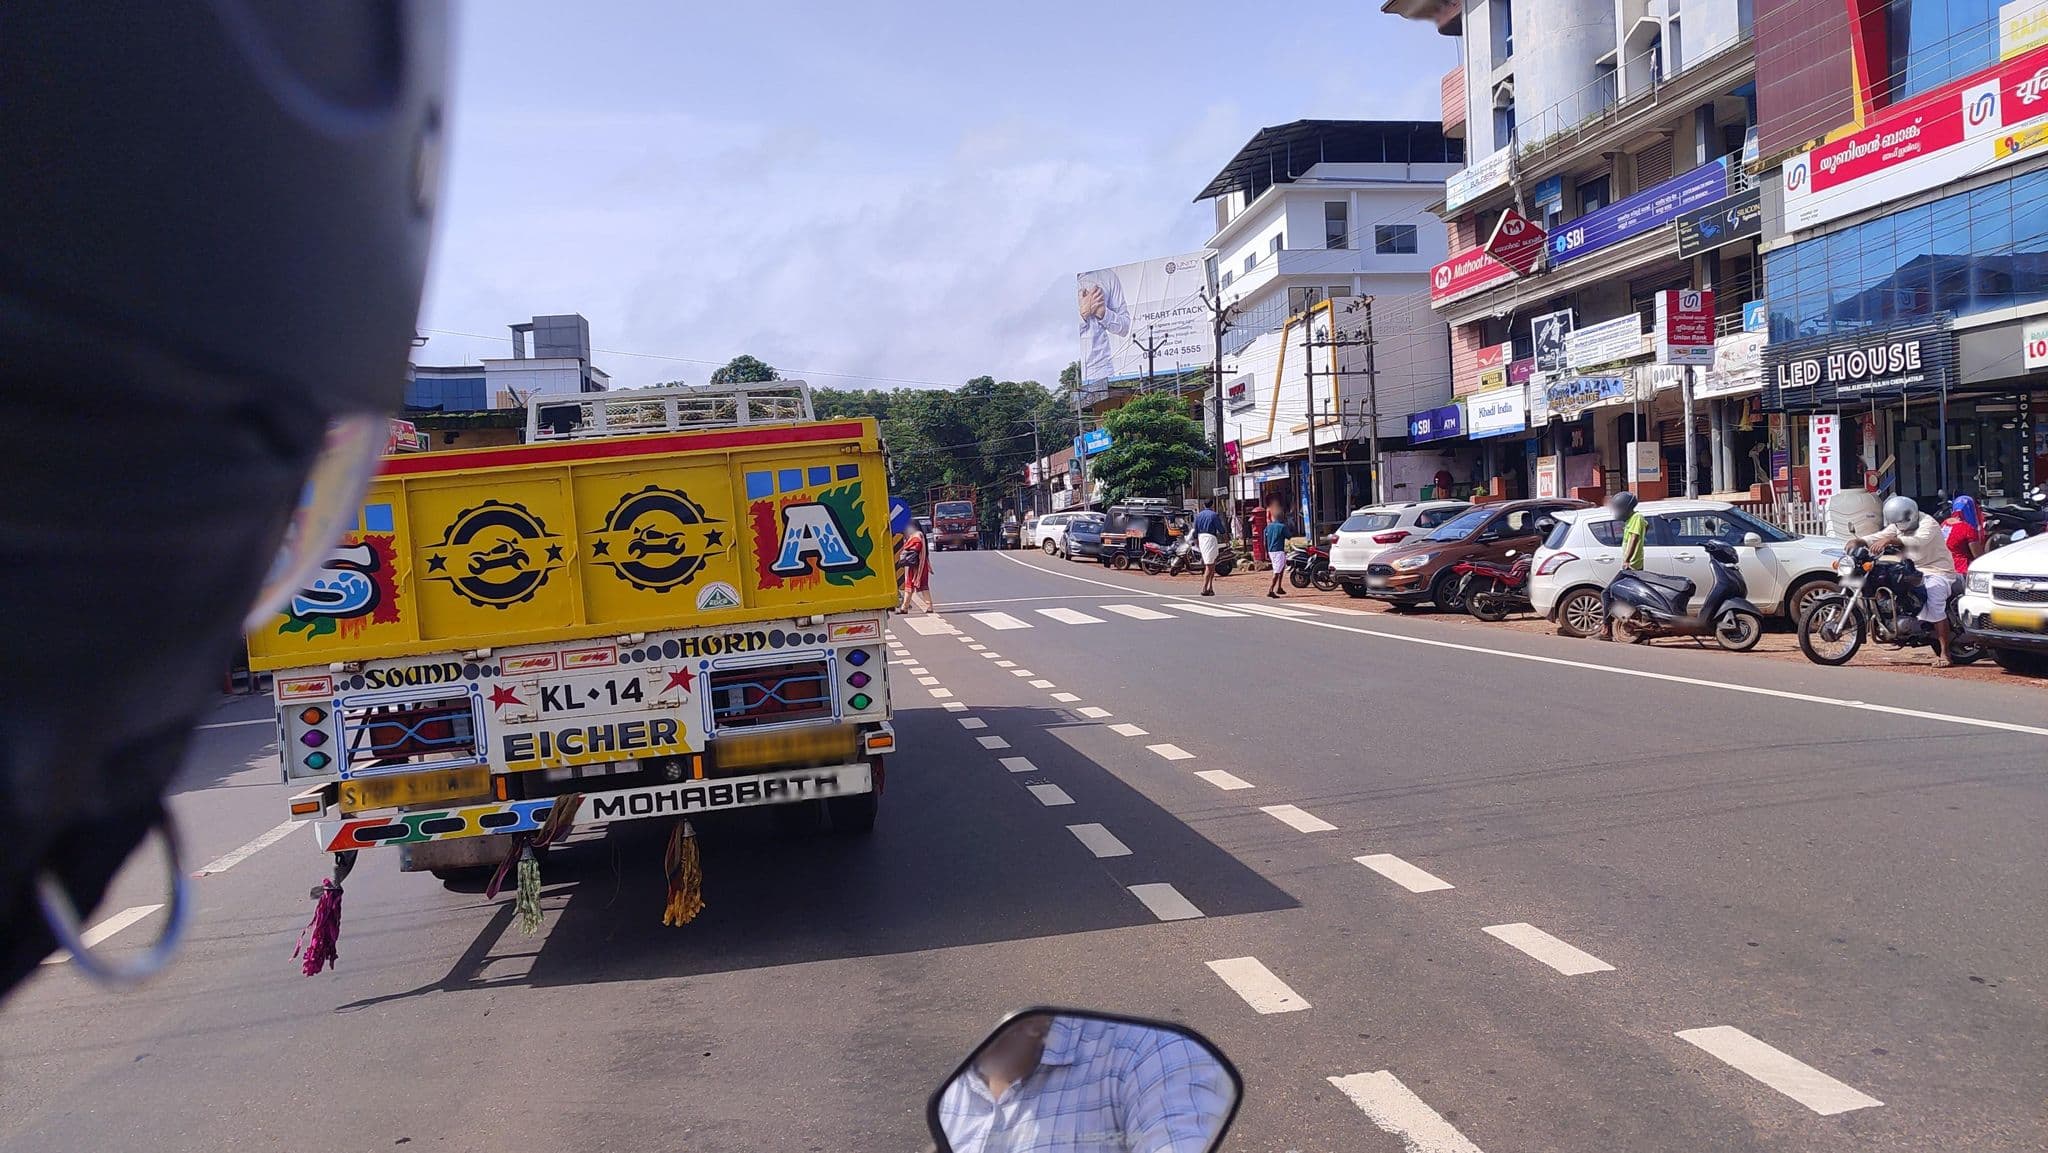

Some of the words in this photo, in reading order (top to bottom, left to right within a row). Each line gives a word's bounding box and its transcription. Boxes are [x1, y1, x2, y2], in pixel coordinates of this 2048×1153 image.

[1566, 227, 1584, 249] SBI
[1453, 254, 1484, 279] Muthoot
[1143, 350, 1161, 359] 024
[1164, 347, 1179, 356] 424
[1181, 344, 1201, 355] 5555
[1777, 359, 1821, 390] LED
[1827, 340, 1922, 382] HOUSE
[1418, 419, 1431, 435] SBI
[1443, 418, 1456, 430] ATM
[2022, 445, 2032, 501] ELECTR
[769, 501, 864, 578] A
[679, 629, 768, 660] HORN
[364, 661, 463, 691] SOUND
[502, 716, 679, 763] EICHER
